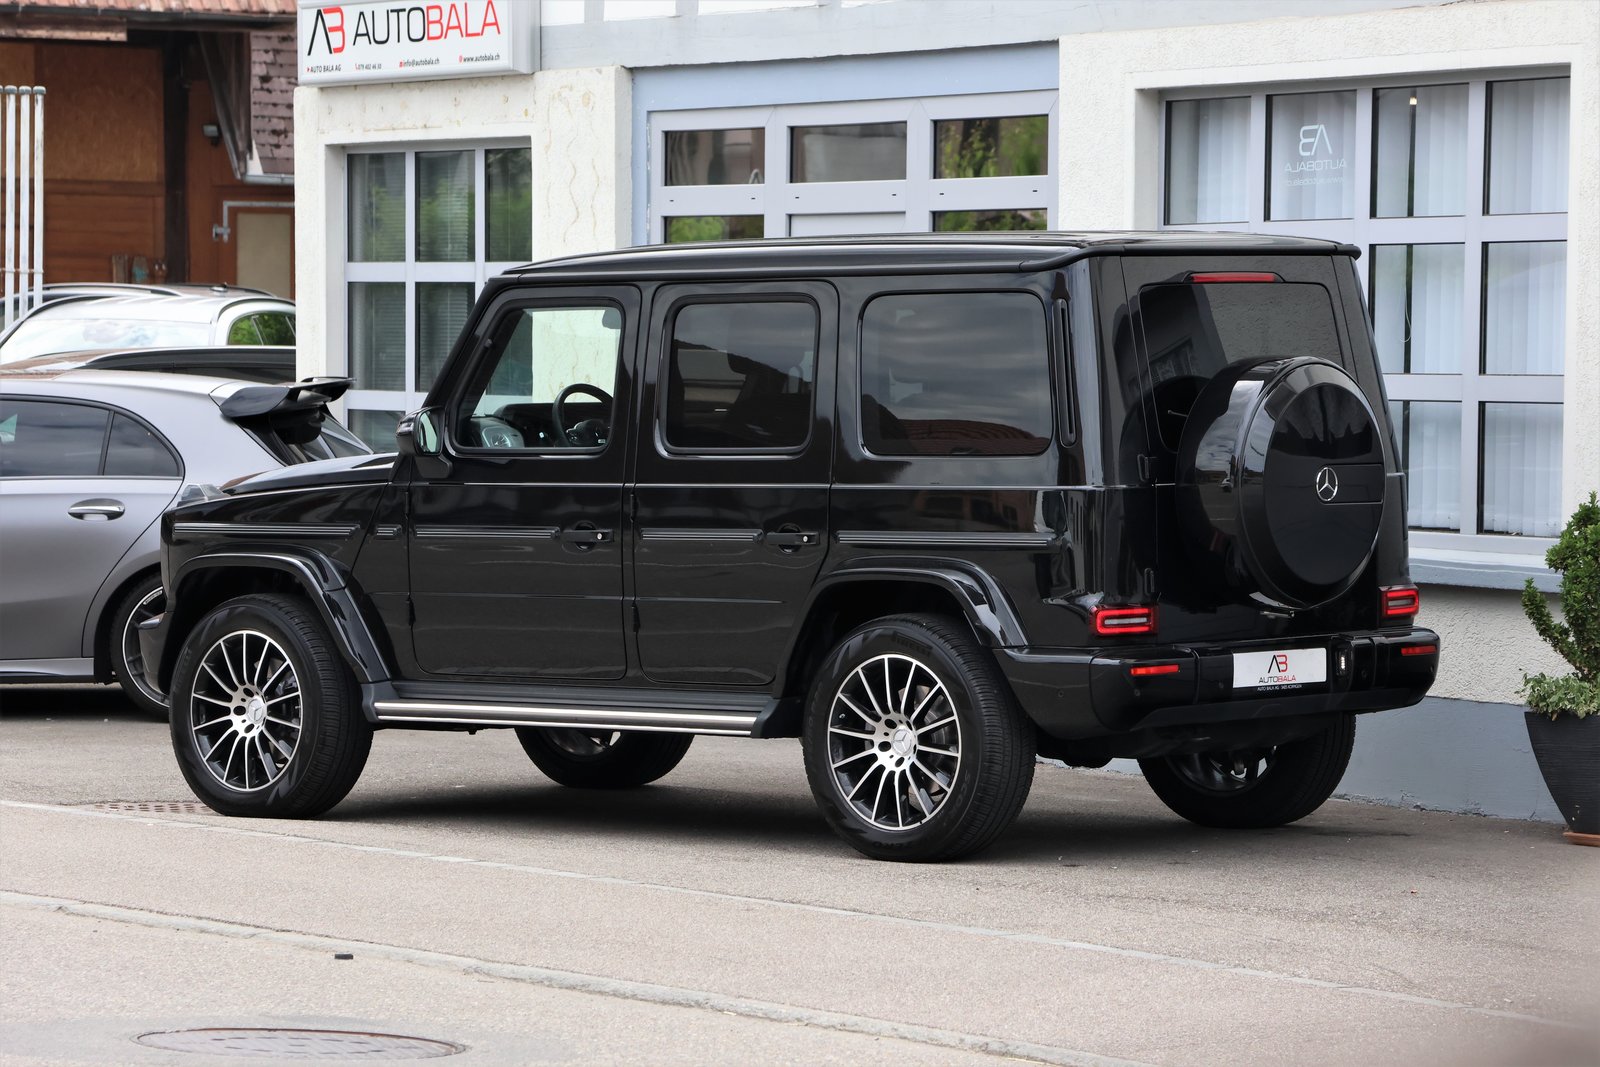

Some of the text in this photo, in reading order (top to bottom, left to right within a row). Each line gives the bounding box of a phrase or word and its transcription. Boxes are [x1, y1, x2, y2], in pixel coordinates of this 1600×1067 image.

[352, 0, 501, 46] AUTOBALA
[403, 57, 440, 68] info@autobala.ch
[463, 53, 500, 63] www.autobala.ch
[310, 65, 322, 73] AUTO
[323, 64, 334, 72] BALA
[1258, 675, 1296, 684] AUTOBALA
